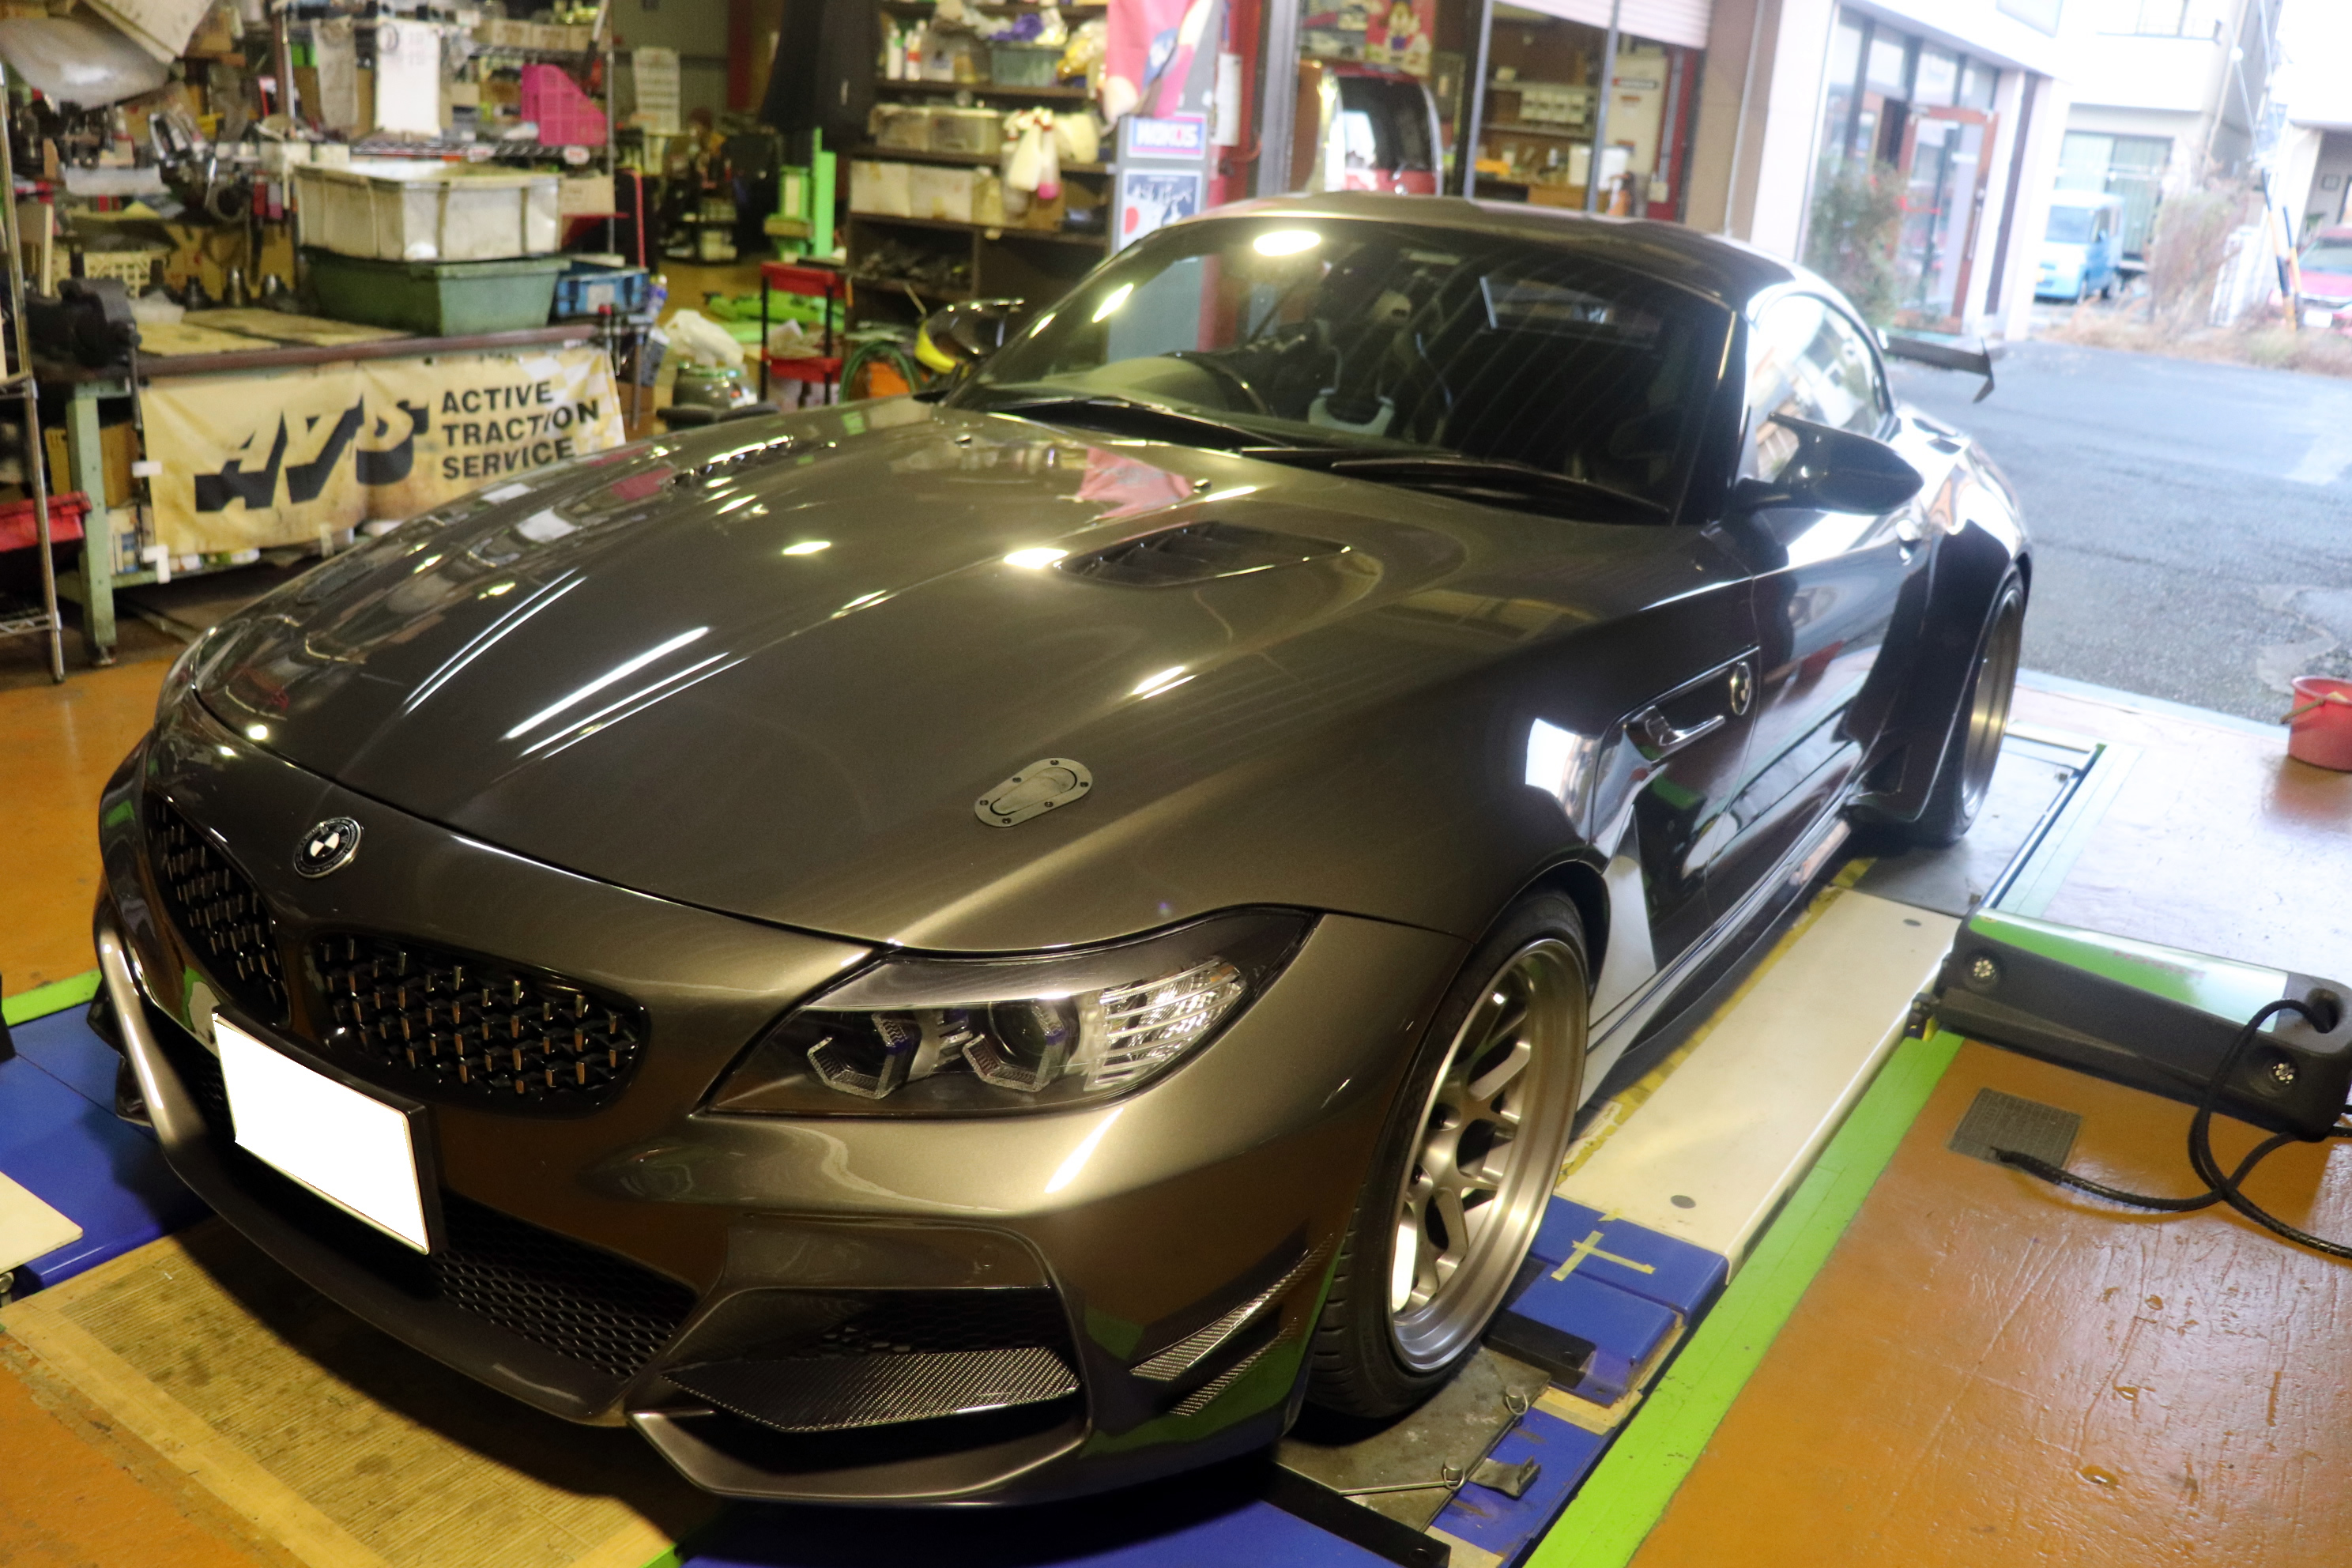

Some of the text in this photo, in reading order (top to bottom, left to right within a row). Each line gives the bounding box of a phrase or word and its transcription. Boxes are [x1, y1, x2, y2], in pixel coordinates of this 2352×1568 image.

[442, 381, 553, 414] ACTIVE
[442, 398, 599, 447] TRACTION
[443, 437, 575, 480] SERVICE
